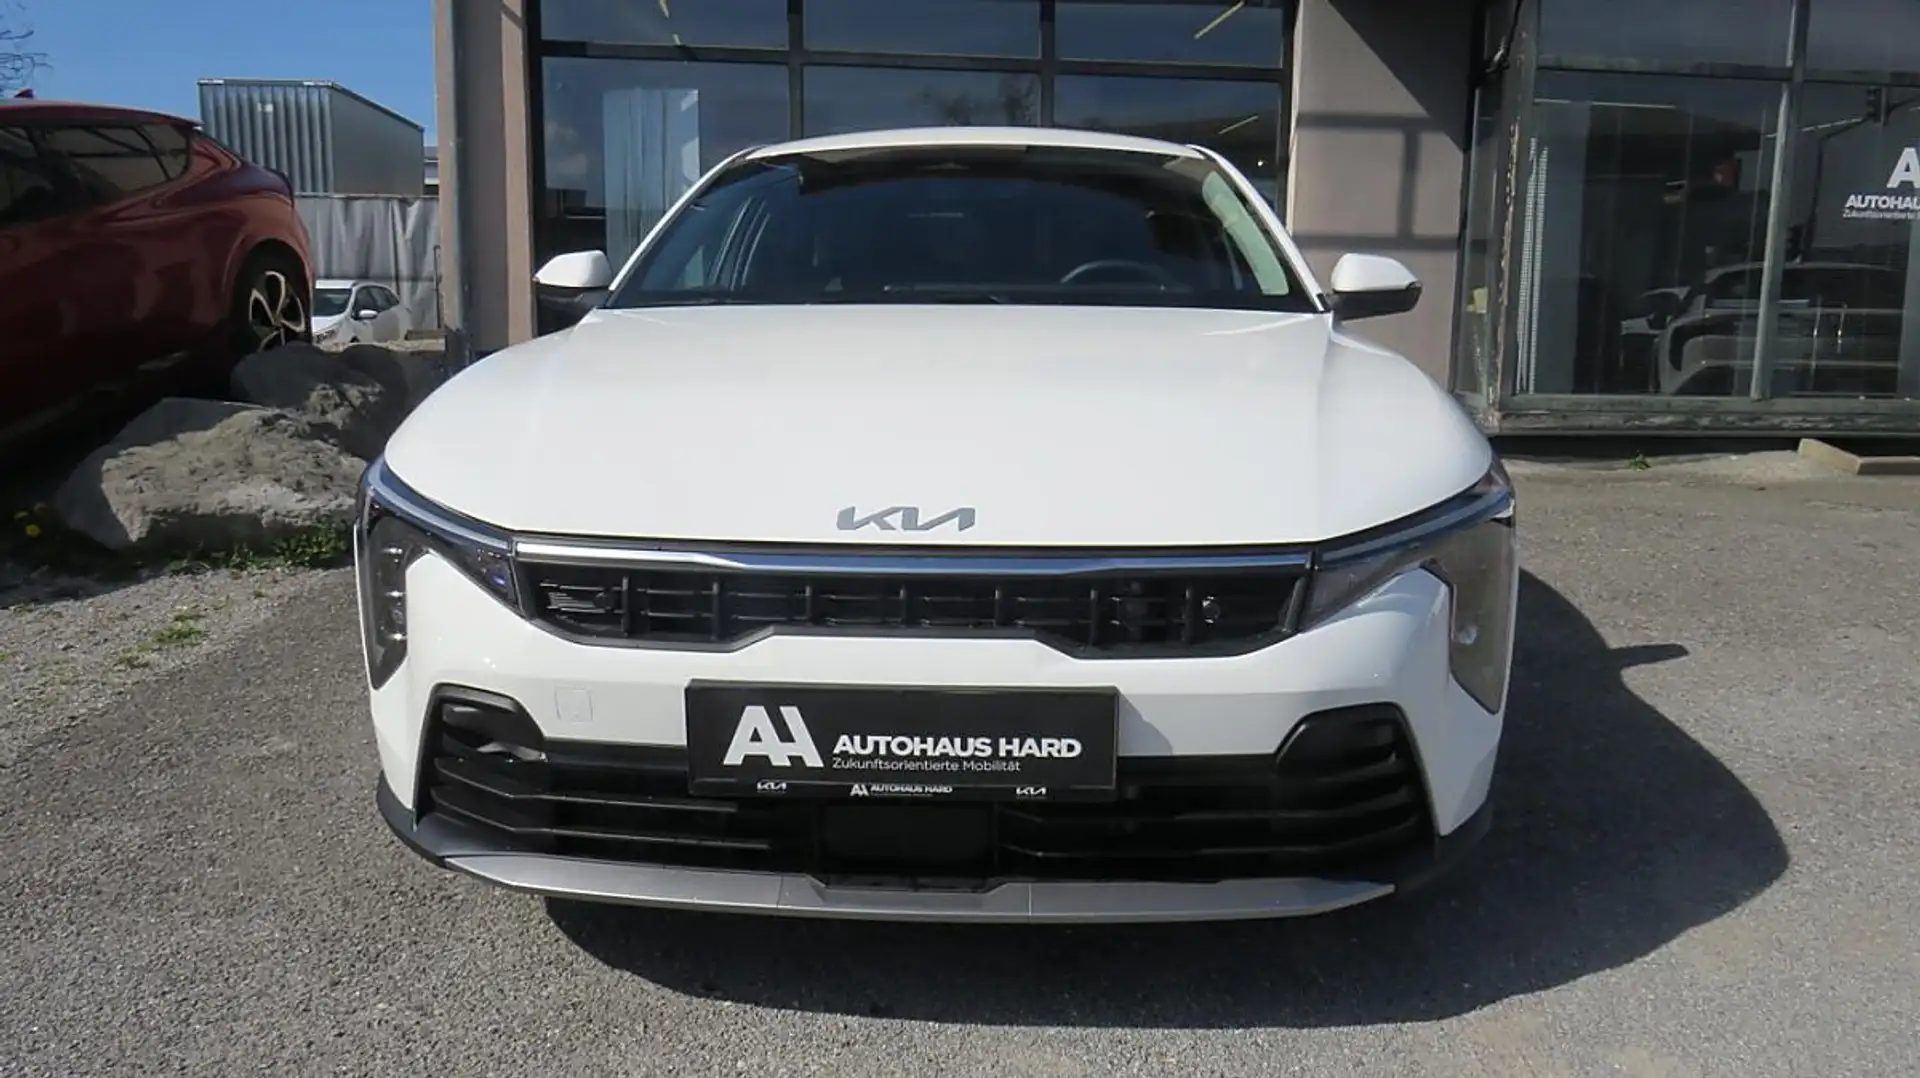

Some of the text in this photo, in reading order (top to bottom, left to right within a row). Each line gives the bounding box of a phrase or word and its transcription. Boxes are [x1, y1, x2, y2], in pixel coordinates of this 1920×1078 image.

[836, 506, 976, 532] KIA
[833, 734, 1083, 759] AUTOHAUS HARD
[833, 757, 1021, 773] Zukunftsorientierte Mobilität
